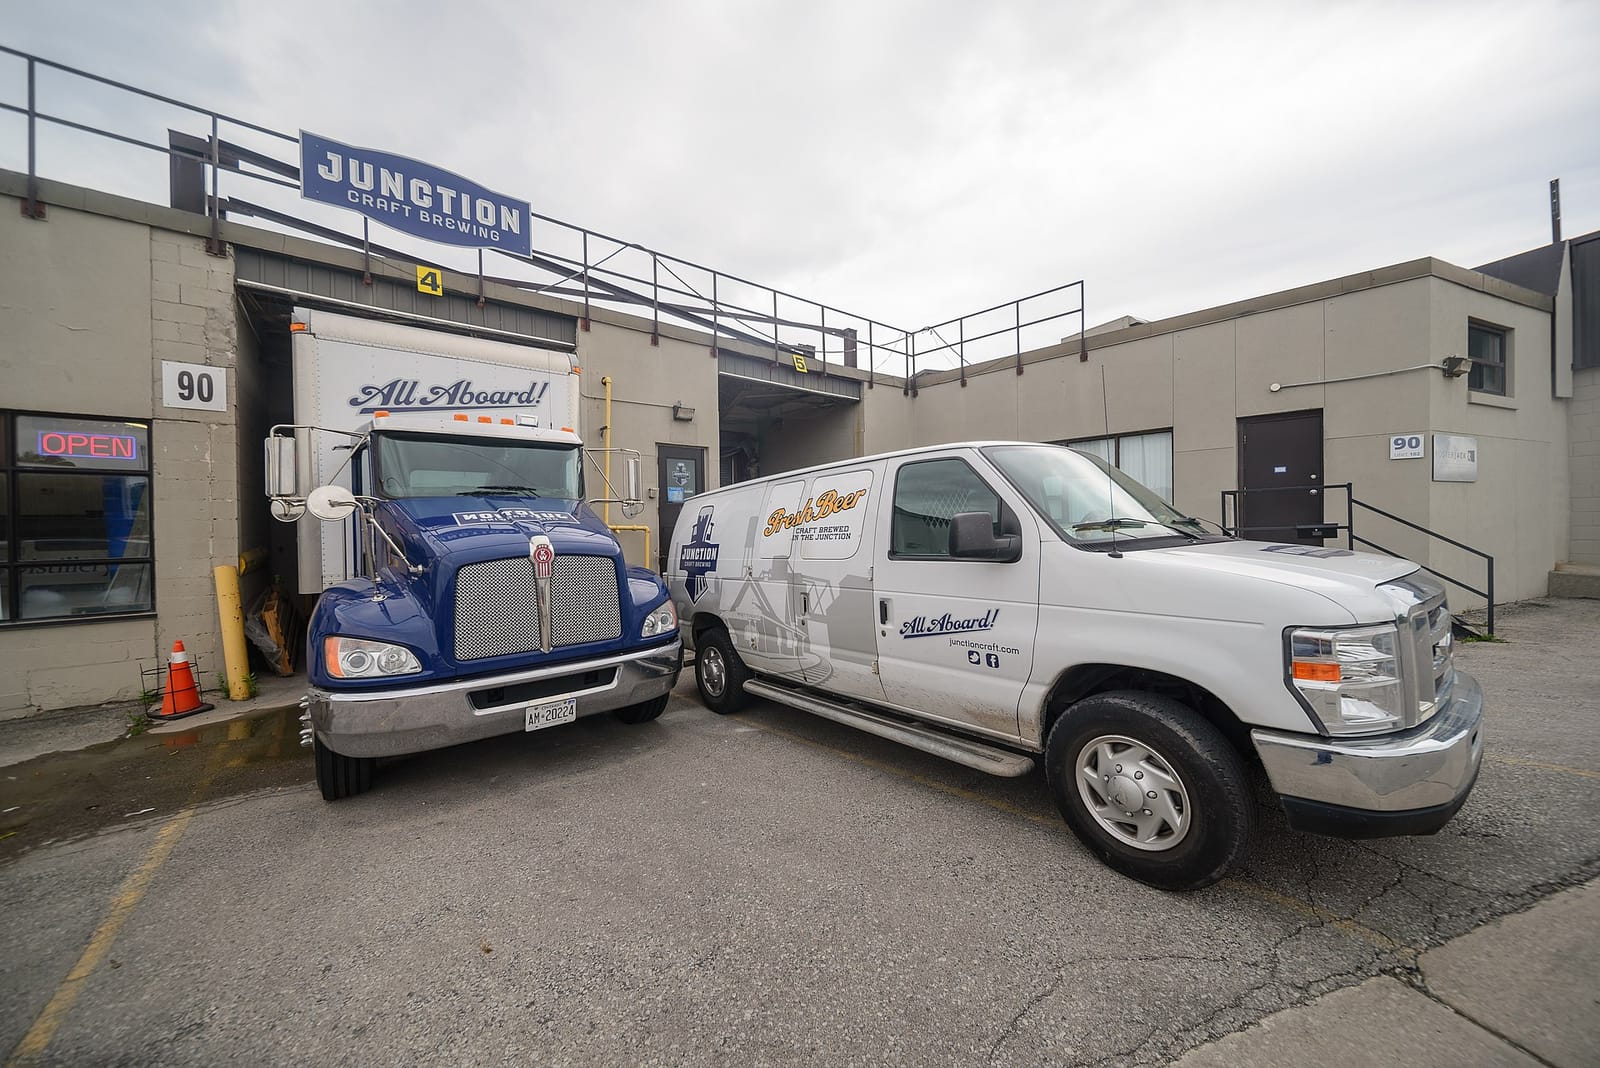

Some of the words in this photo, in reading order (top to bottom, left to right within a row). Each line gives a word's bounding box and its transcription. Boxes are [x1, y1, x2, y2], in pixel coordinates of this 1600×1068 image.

[317, 151, 520, 234] JUNCTION
[347, 189, 412, 217] CRAFT
[419, 209, 500, 241] BREWING
[420, 271, 441, 292] 4
[796, 357, 805, 370] 5
[177, 370, 213, 402] 90
[349, 379, 418, 406] All
[419, 380, 549, 406] Aboard!
[42, 433, 133, 457] OPEN
[1393, 436, 1421, 450] 90
[763, 498, 813, 536] Fresh
[812, 489, 866, 521] Beer
[819, 525, 849, 533] BREWED
[681, 547, 718, 560] JUNCTION
[900, 616, 926, 634] All
[927, 608, 999, 632] Aboard!
[949, 638, 1019, 655] junctioncraft.com
[545, 705, 574, 721] 20224
